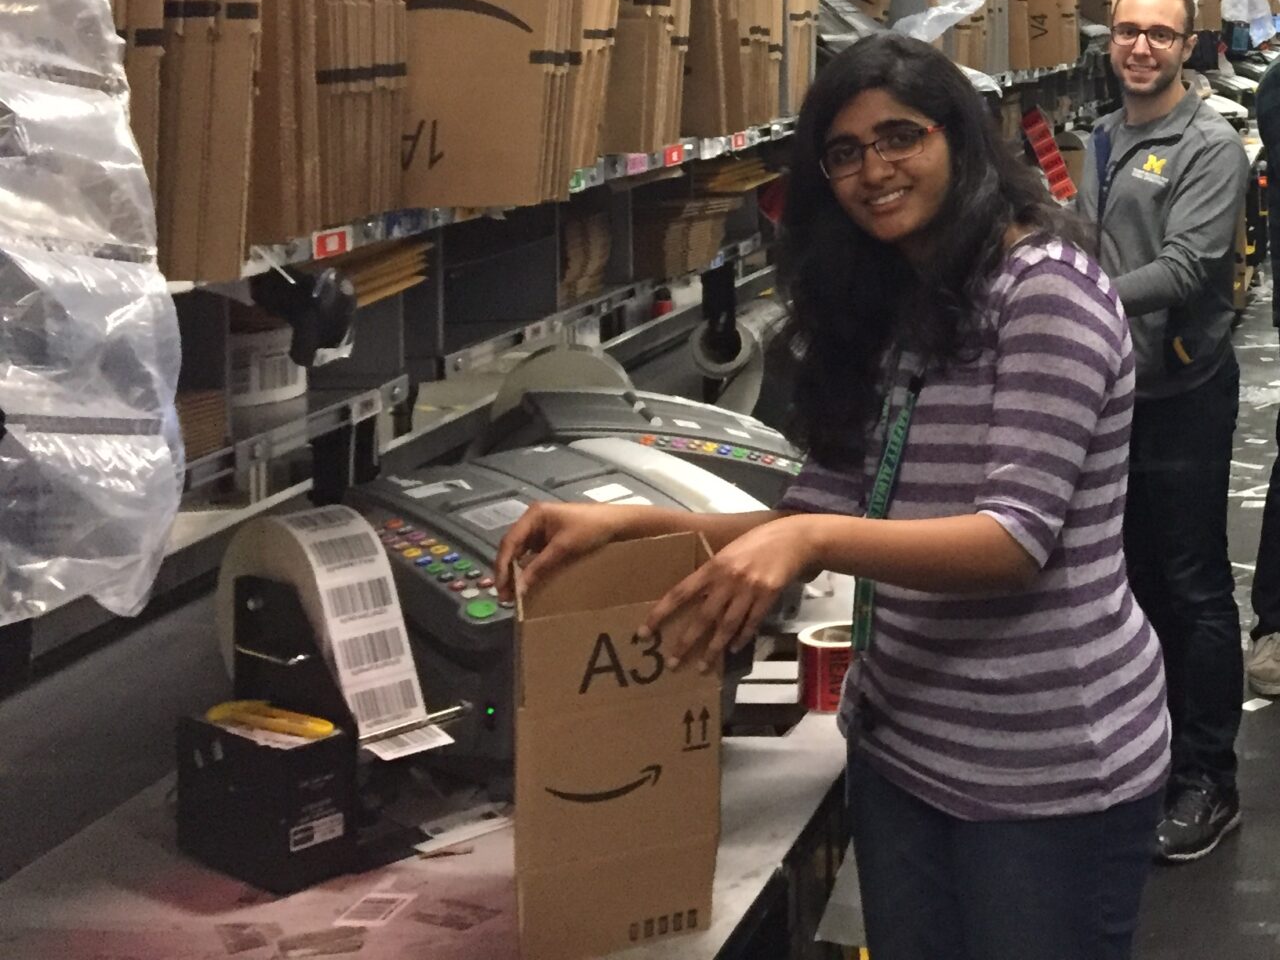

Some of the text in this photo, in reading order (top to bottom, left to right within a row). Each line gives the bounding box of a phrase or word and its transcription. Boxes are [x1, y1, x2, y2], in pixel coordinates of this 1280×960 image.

[1030, 14, 1048, 40] V4
[1143, 153, 1167, 175] M
[578, 629, 665, 695] A3
